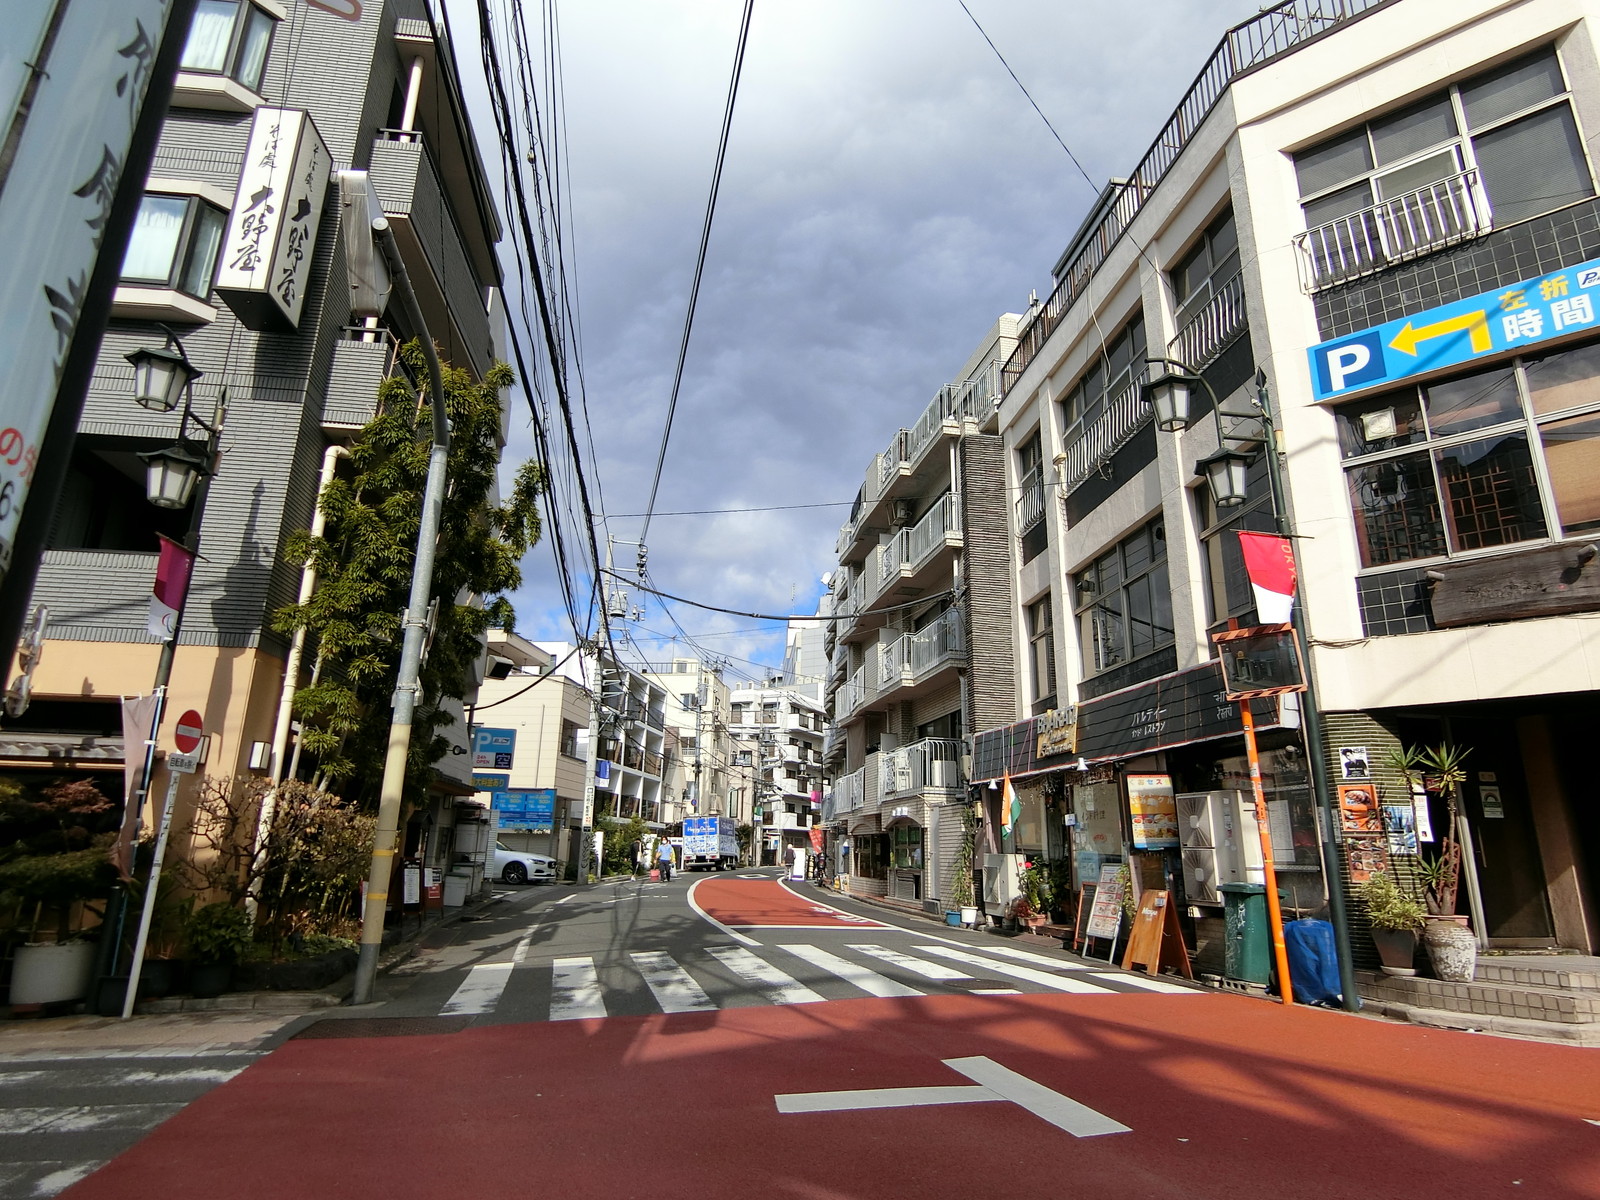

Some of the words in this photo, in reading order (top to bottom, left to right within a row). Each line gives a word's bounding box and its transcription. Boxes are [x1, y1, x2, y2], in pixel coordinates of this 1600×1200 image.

[229, 185, 275, 272] 大野屋
[1498, 275, 1569, 312] 左折
[1326, 343, 1370, 391] P
[476, 733, 492, 753] P
